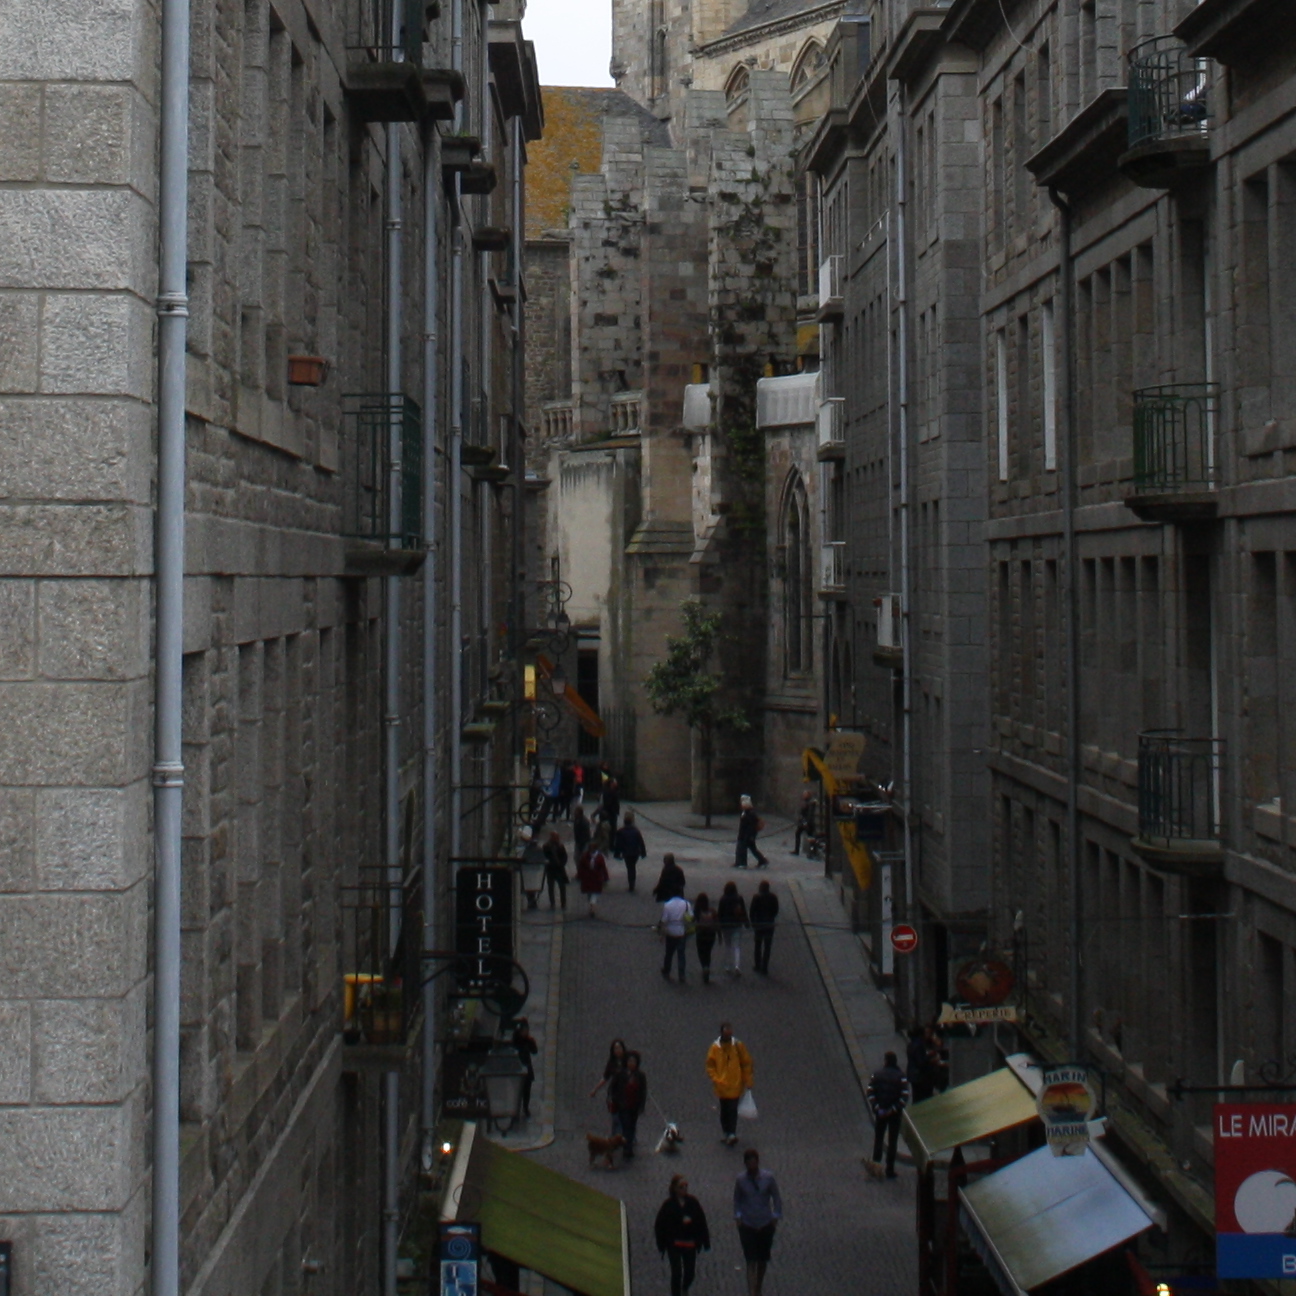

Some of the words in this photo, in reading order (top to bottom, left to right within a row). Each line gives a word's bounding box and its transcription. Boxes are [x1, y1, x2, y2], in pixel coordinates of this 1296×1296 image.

[475, 872, 493, 976] HOTEL
[445, 1097, 468, 1109] café
[1219, 1115, 1243, 1137] LE
